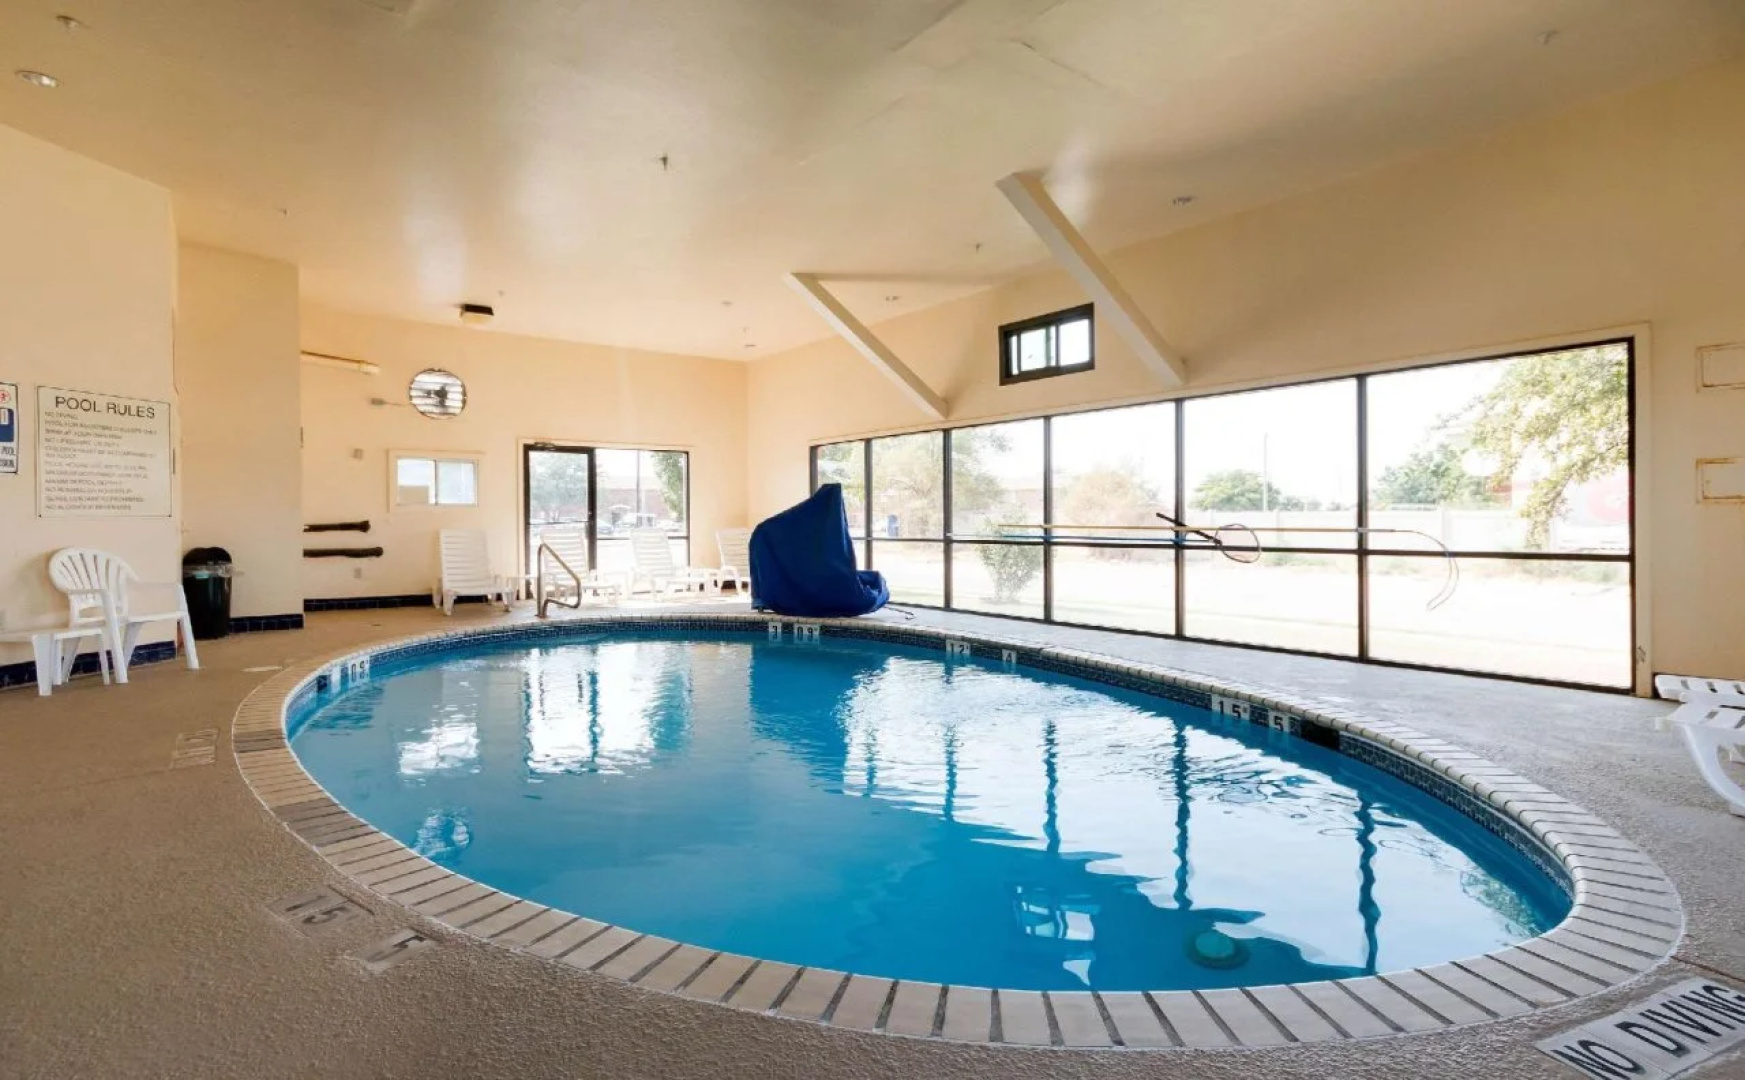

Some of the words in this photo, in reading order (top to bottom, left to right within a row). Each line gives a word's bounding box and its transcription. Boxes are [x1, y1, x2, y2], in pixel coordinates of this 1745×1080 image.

[55, 396, 102, 413] POOL
[106, 402, 155, 420] RULES
[1549, 1038, 1648, 1080] NO
